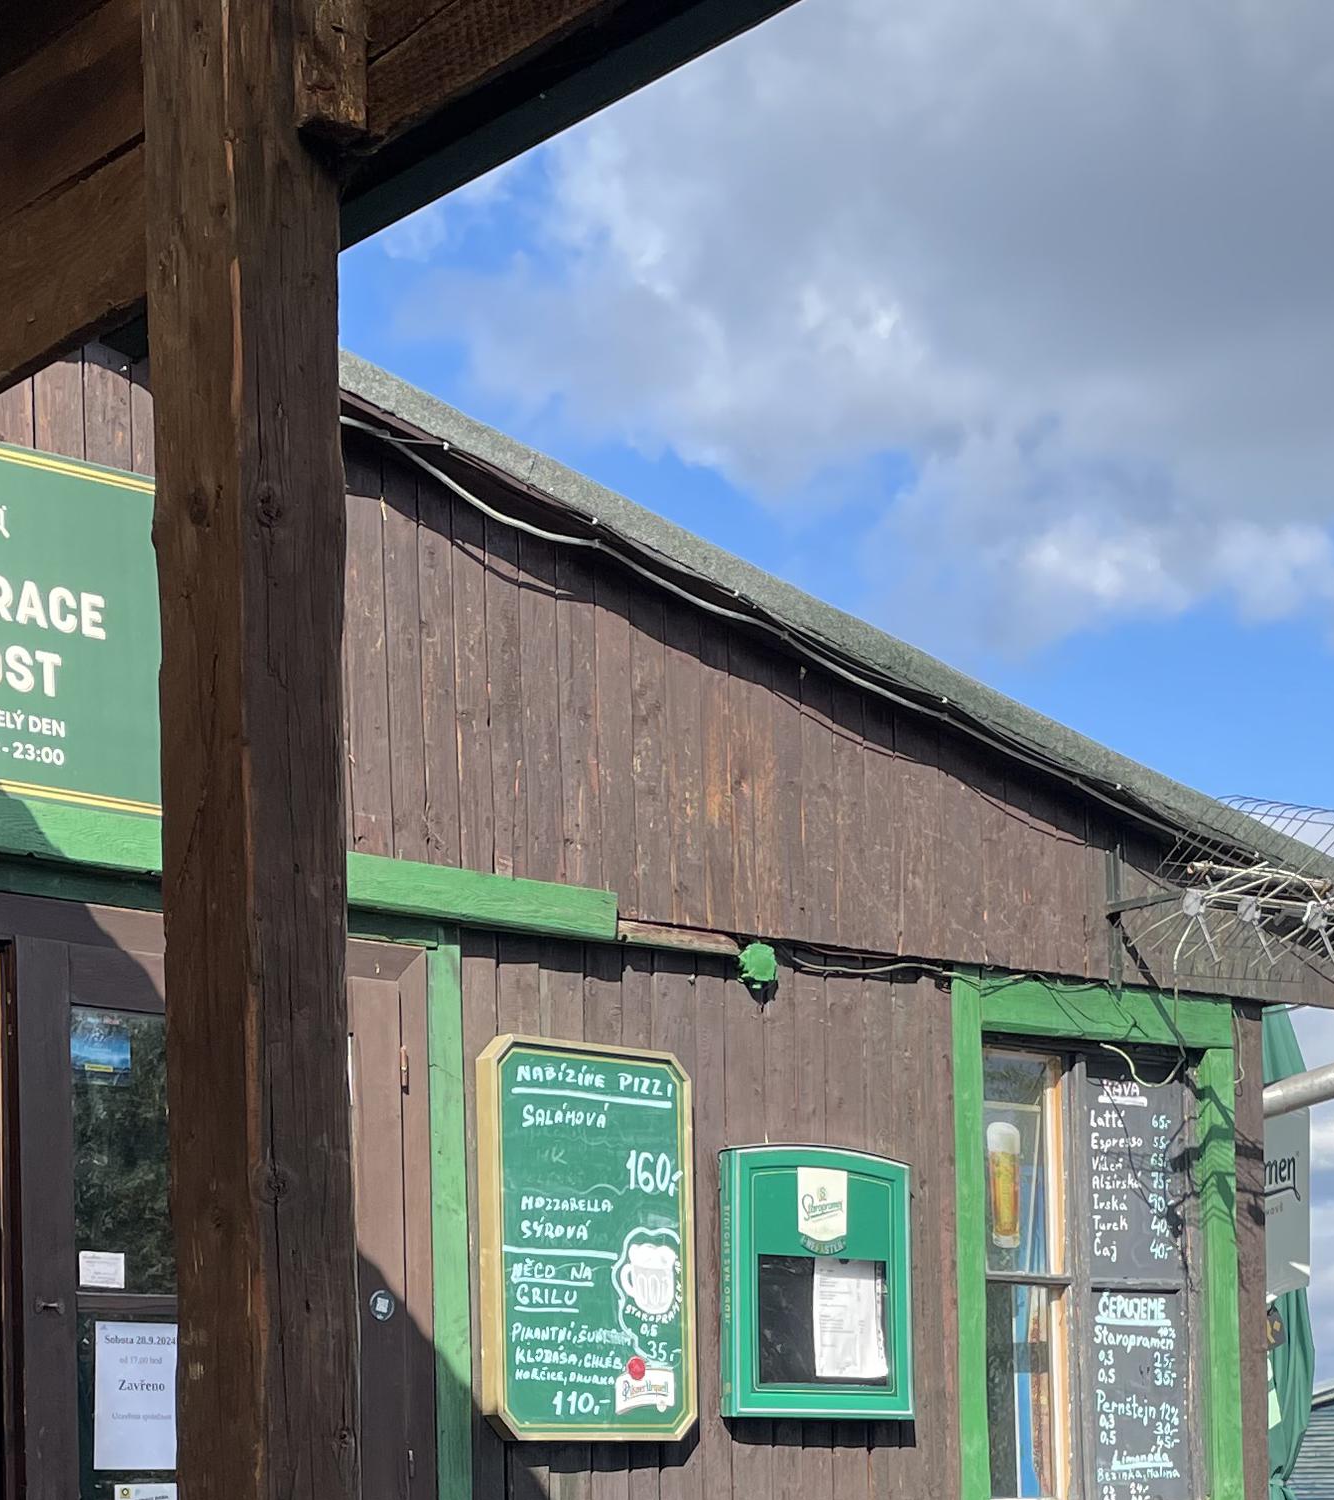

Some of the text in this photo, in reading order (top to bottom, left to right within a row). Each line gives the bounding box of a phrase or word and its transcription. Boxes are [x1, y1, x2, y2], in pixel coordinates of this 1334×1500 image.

[28, 715, 66, 738] DEN
[12, 741, 65, 766] 23:00
[517, 1063, 606, 1088] NABÍZÍME
[522, 1102, 609, 1129] SALÁMOVÁ
[1090, 1132, 1143, 1153] Espresso
[626, 1150, 683, 1197] 160,-
[521, 1195, 613, 1213] MOZZARELLA
[1093, 1193, 1127, 1211] Irská
[520, 1216, 592, 1240] SÝROVÁ
[1092, 1214, 1128, 1231] Turek
[1094, 1231, 1117, 1262] Čaj
[511, 1258, 593, 1281] NĚCO NA
[517, 1284, 577, 1305] GRILU
[104, 1335, 134, 1344] Sobota
[1094, 1325, 1174, 1353] Staropramen
[647, 1341, 682, 1362] 35,-
[118, 1379, 165, 1392] Zavřeno
[552, 1390, 611, 1417] 110,-
[1096, 1389, 1156, 1426] Pernštejn
